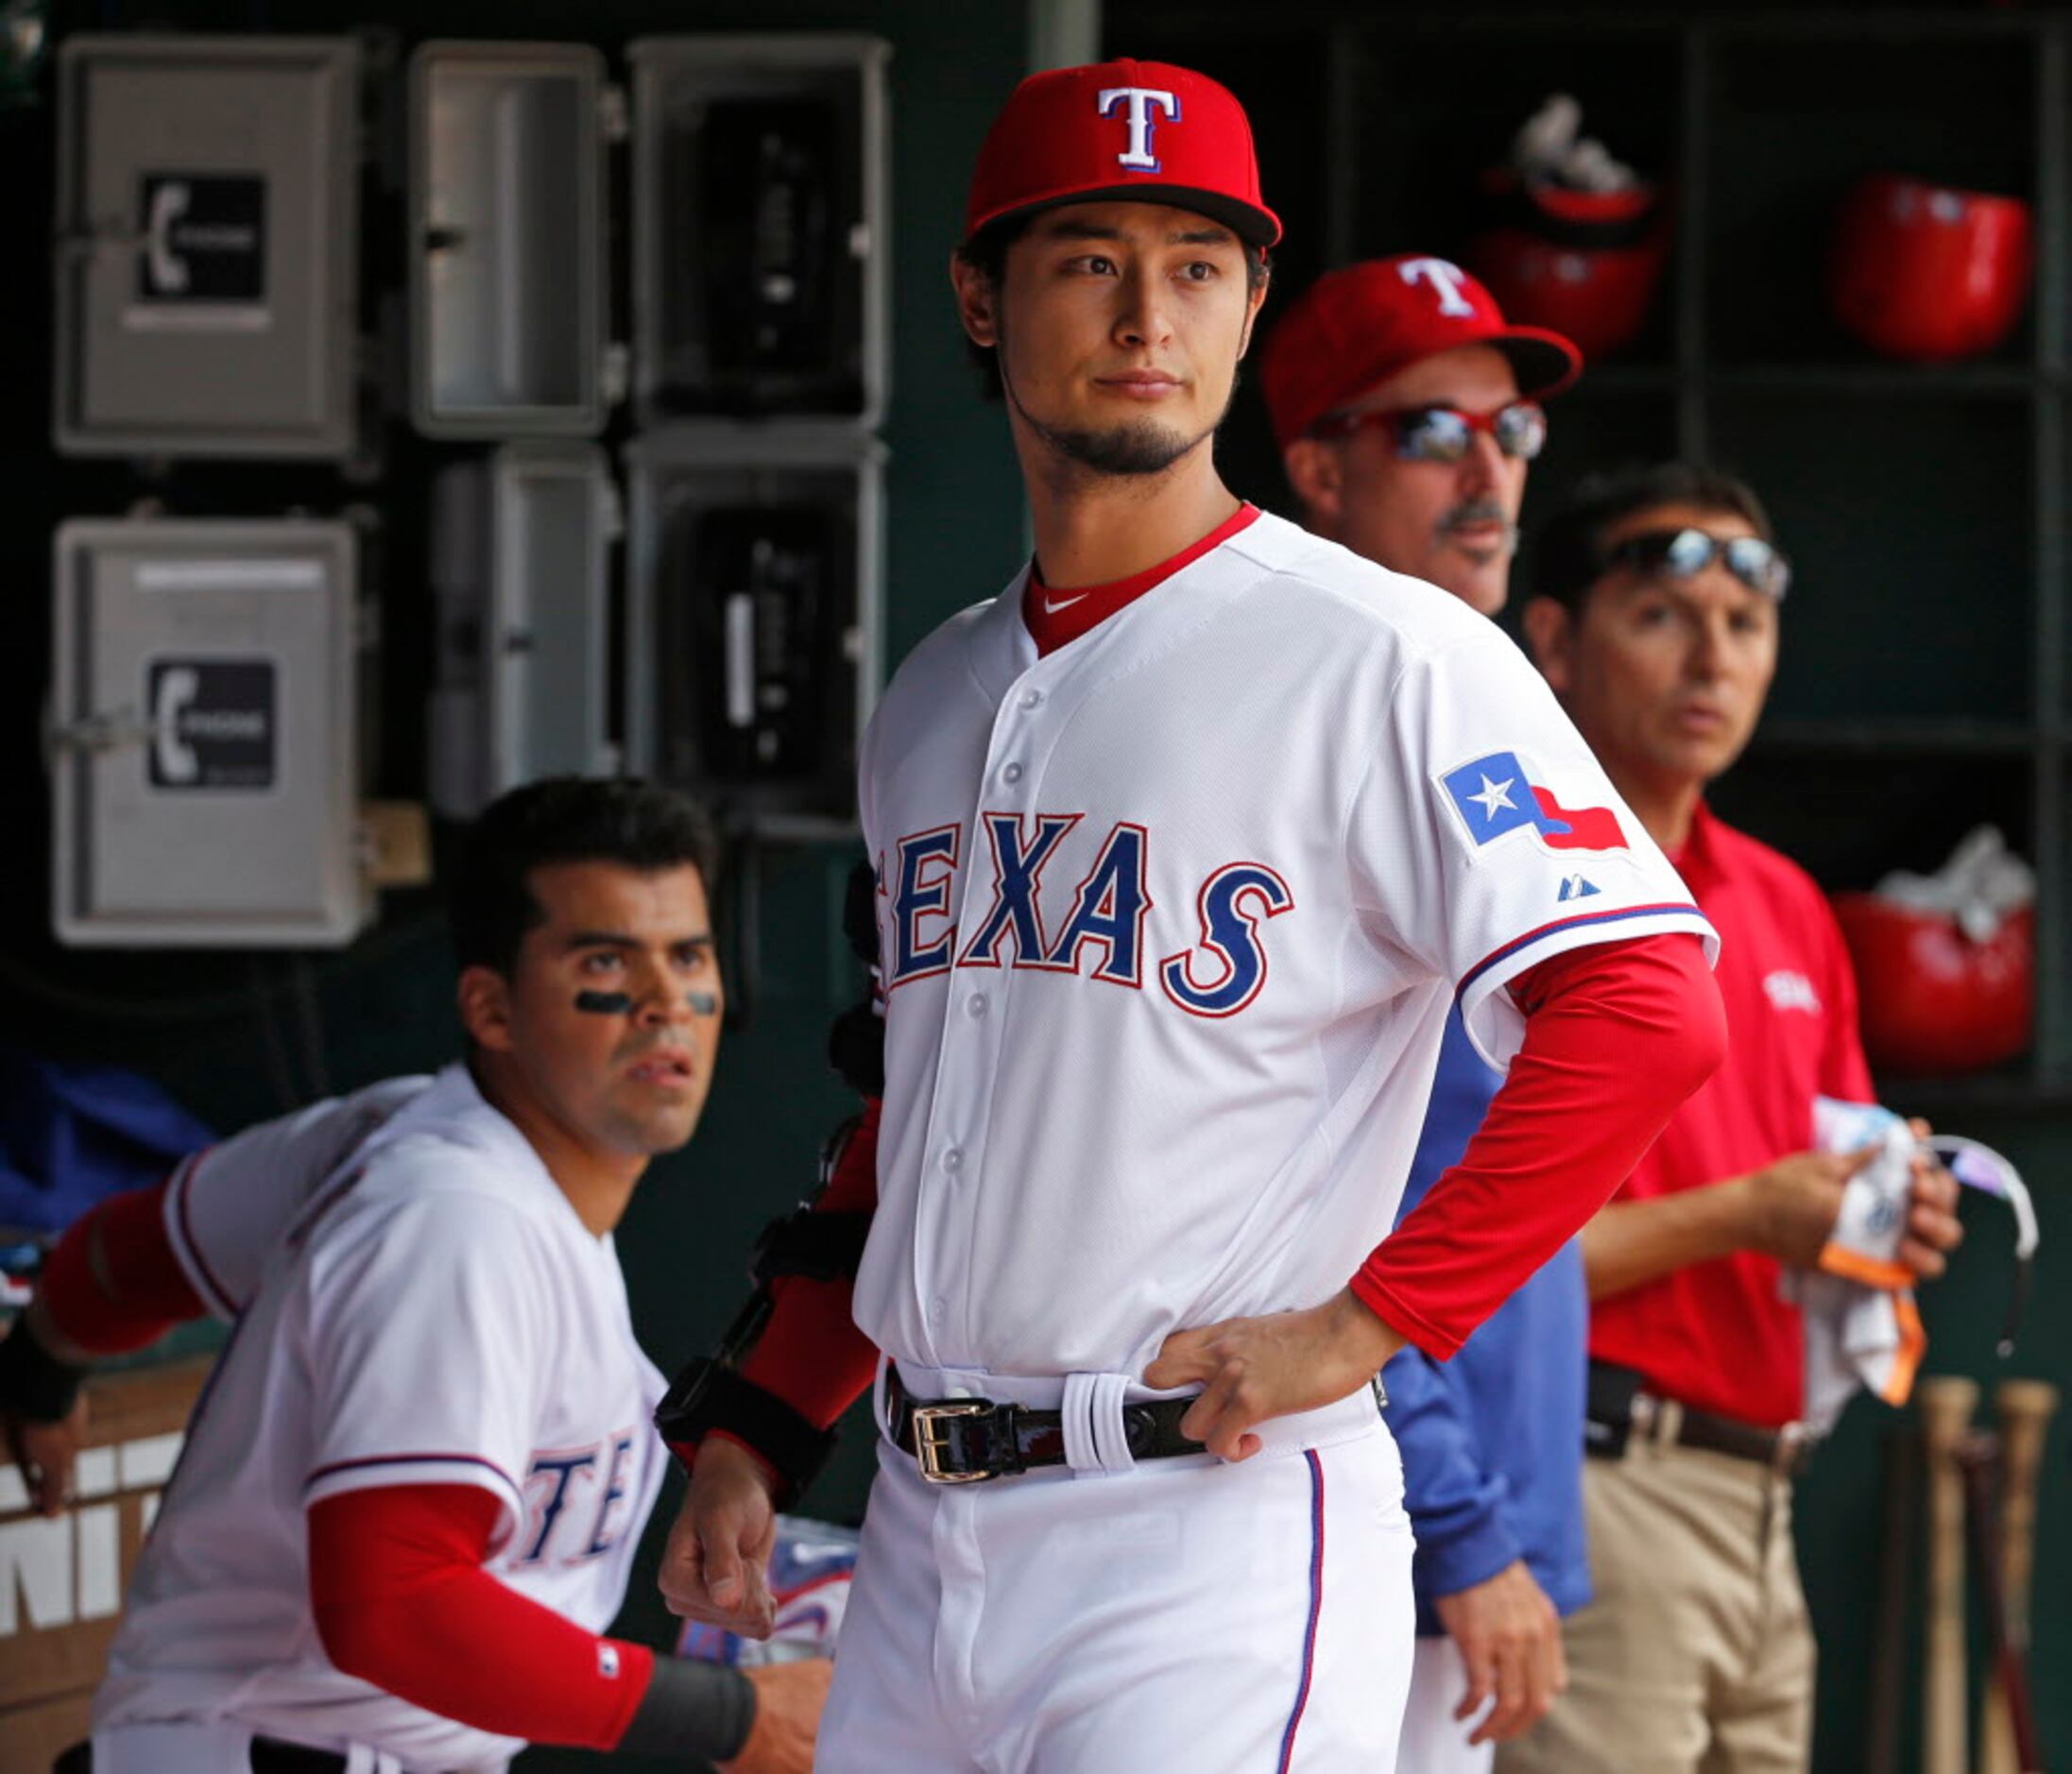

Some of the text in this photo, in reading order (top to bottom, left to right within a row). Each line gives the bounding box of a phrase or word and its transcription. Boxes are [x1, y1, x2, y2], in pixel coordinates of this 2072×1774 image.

[1099, 87, 1182, 174] T
[1398, 257, 1476, 318] T
[875, 810, 1295, 1018] EXAS
